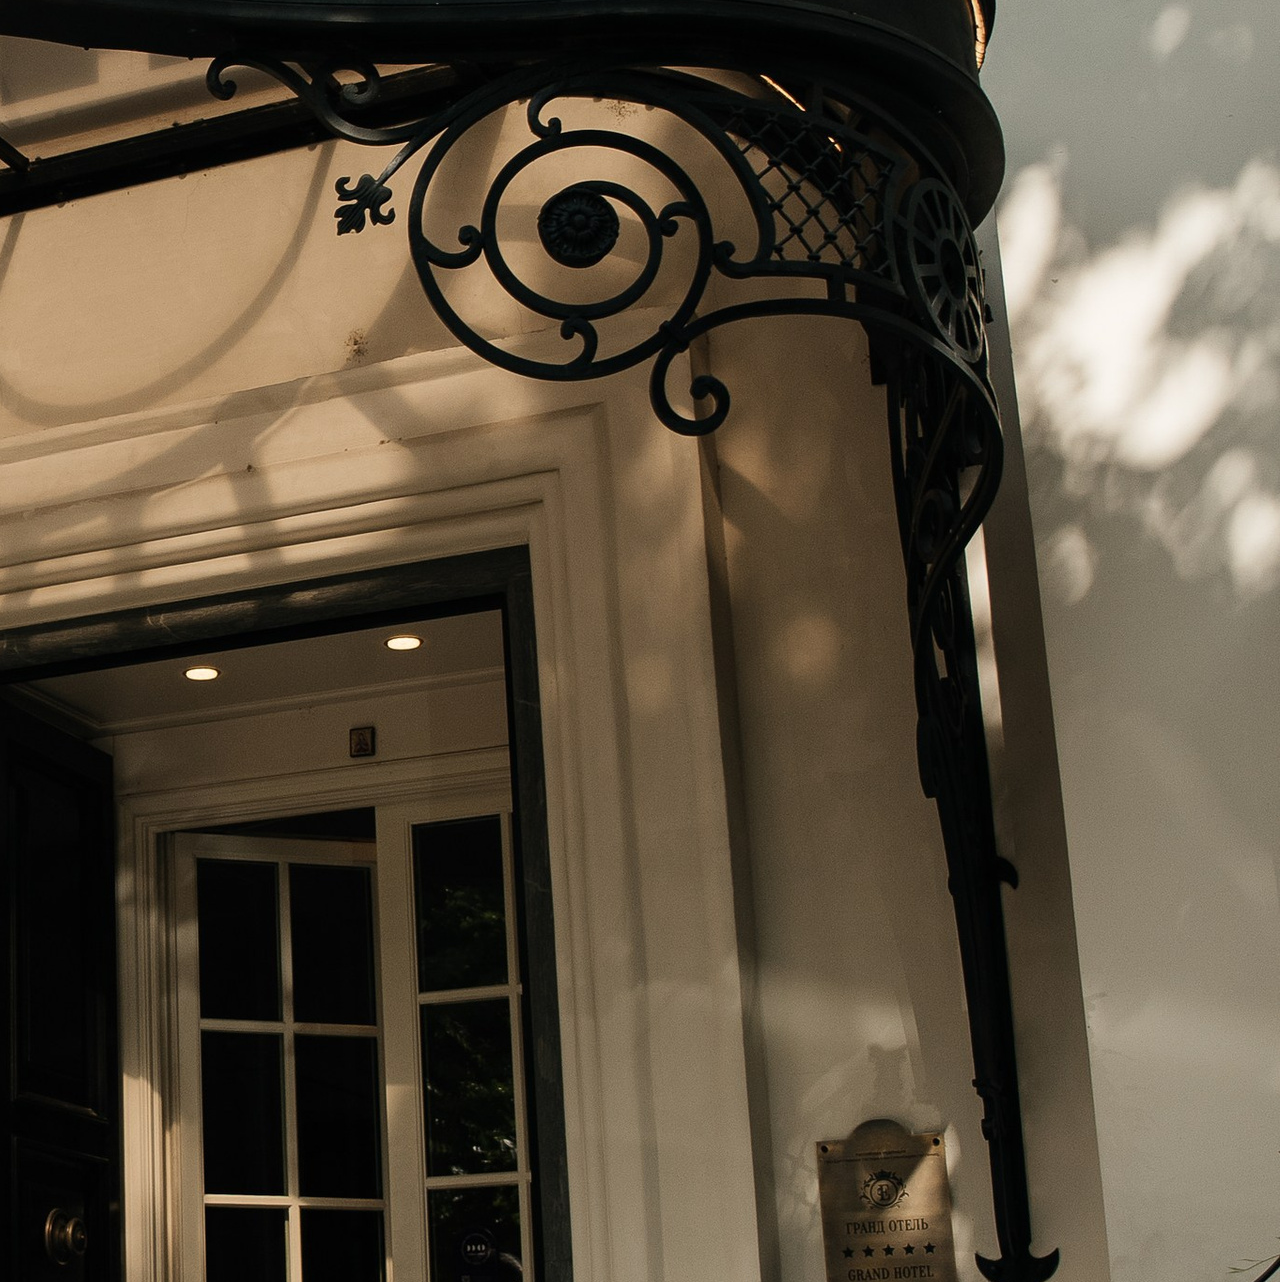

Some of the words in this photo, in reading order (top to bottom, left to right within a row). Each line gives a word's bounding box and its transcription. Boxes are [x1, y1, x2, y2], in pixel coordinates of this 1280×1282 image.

[846, 1220, 885, 1234] ГРАНД
[889, 1218, 928, 1231] ОТЕЛЬ
[848, 1267, 890, 1281] GRAND
[894, 1265, 934, 1279] HOTEL
